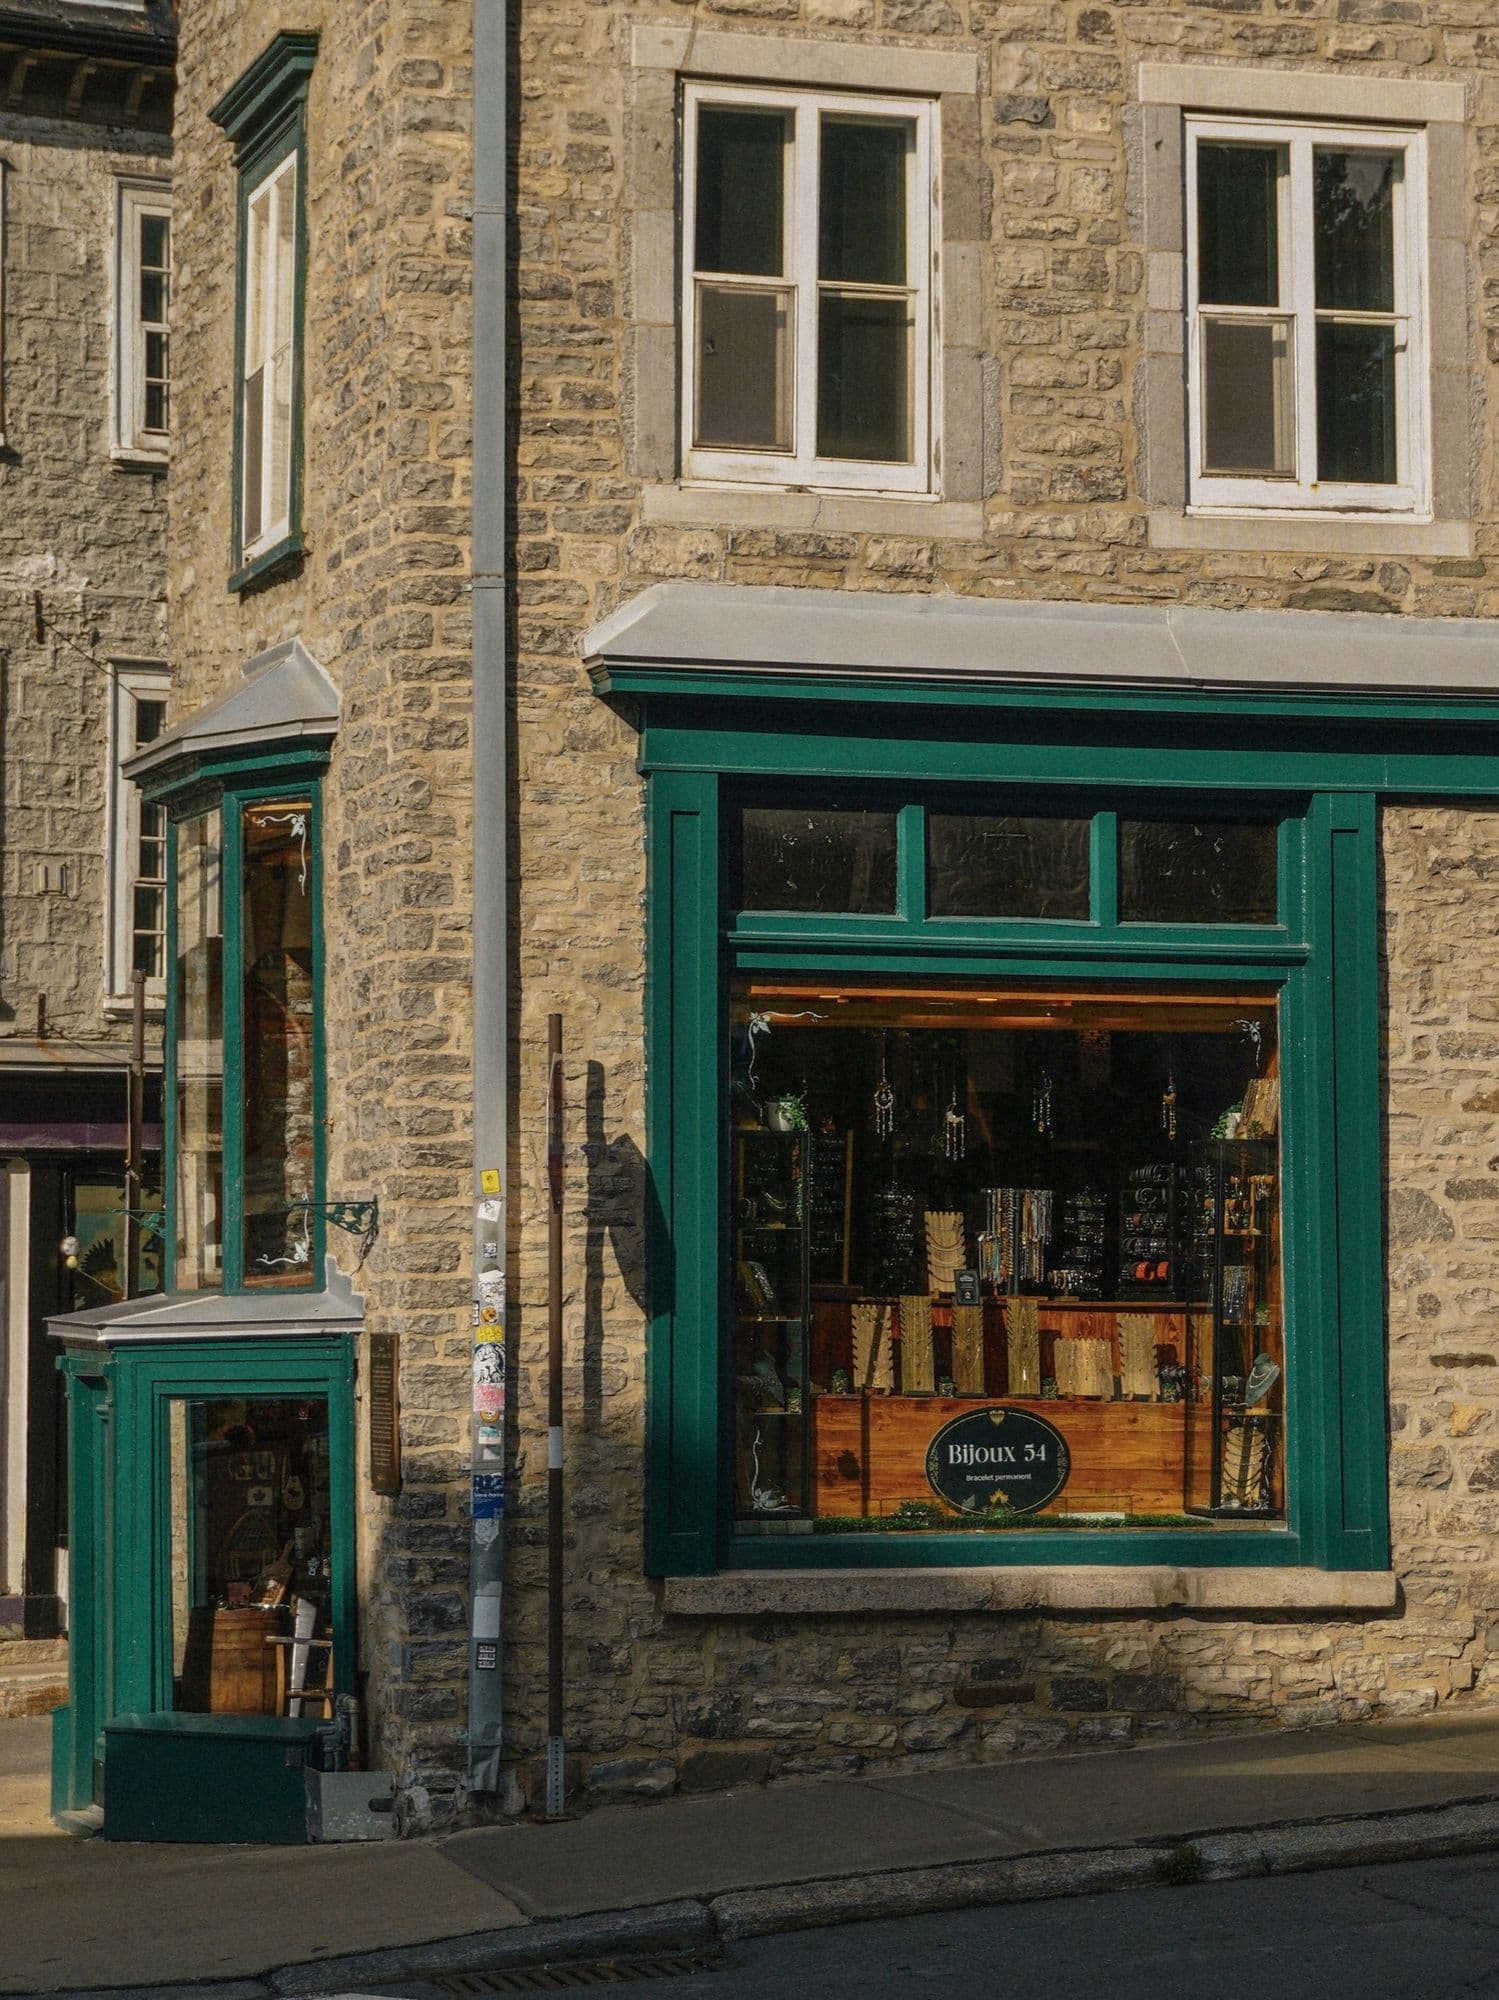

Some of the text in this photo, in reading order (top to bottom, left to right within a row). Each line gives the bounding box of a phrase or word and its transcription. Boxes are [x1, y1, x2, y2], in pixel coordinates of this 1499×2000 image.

[949, 1443, 1046, 1466] Bijoux 54
[966, 1473, 1032, 1482] Bracelet permanent
